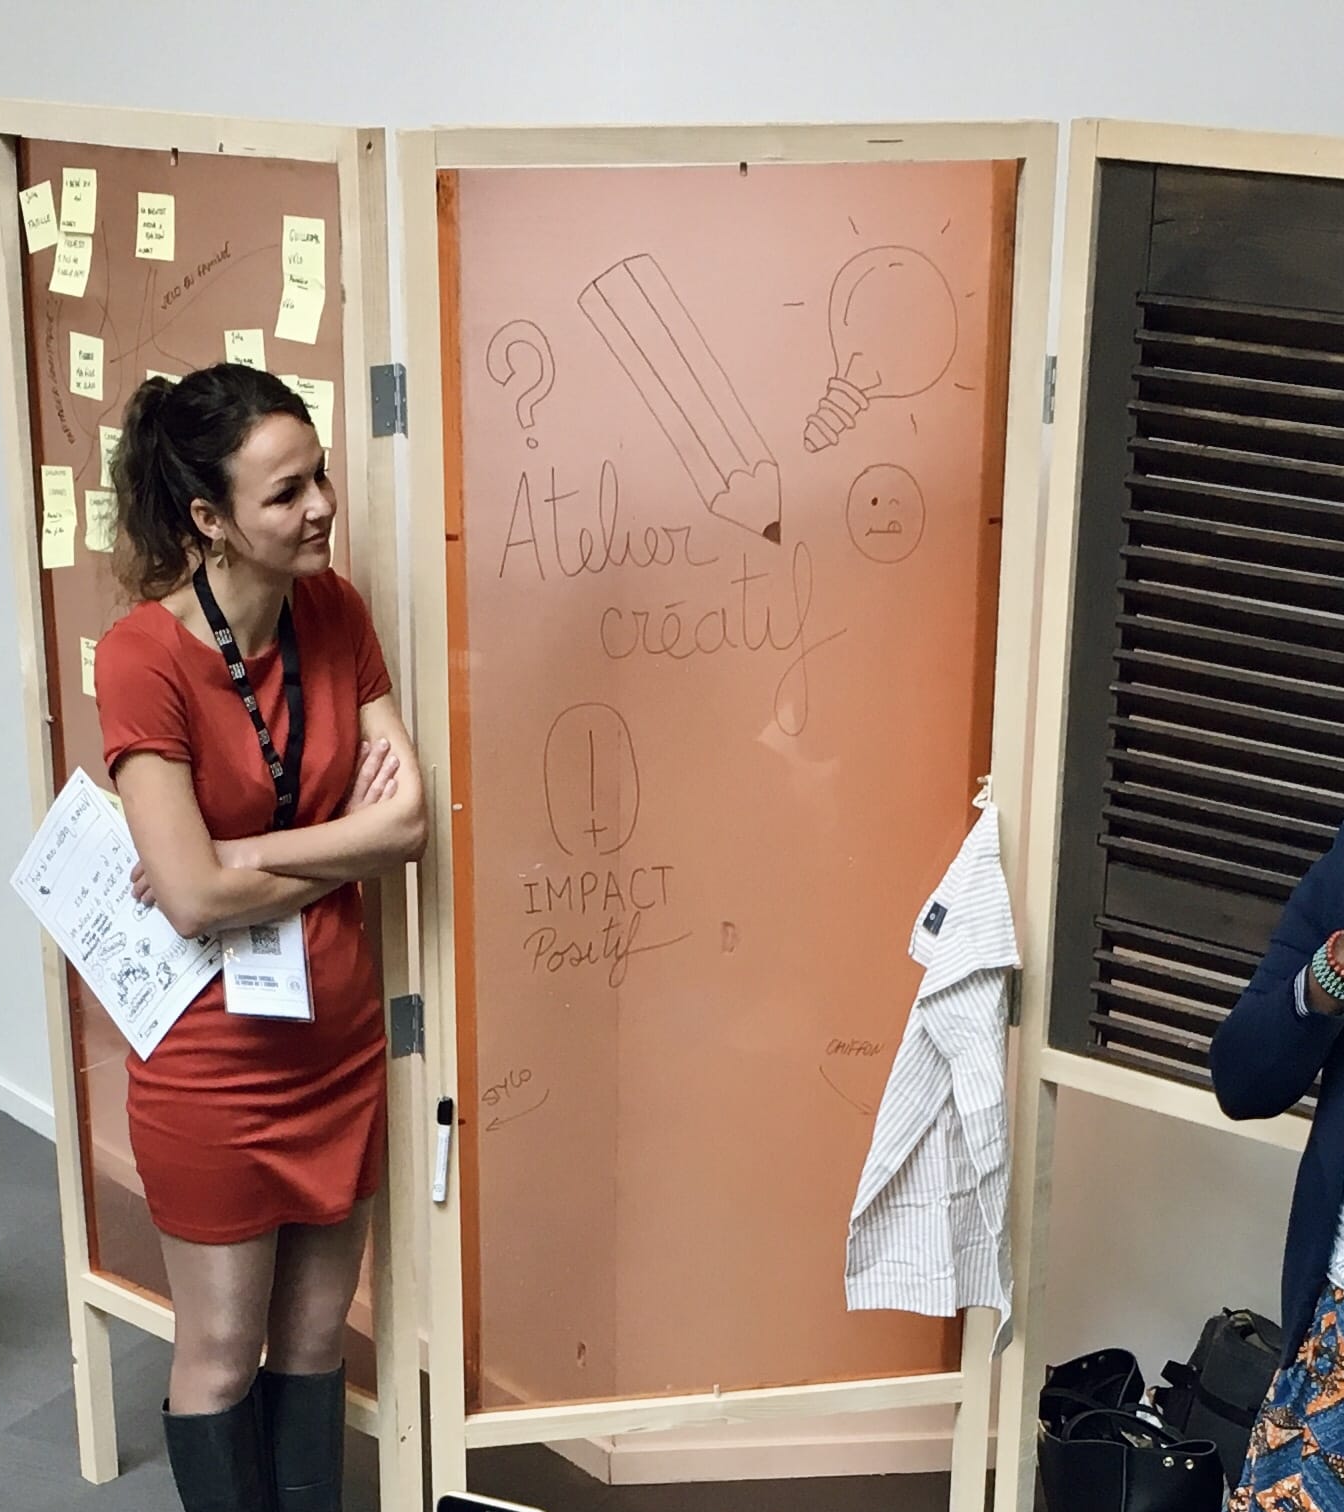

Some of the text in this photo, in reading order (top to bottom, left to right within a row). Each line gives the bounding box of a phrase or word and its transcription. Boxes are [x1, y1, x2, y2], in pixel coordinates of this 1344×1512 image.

[499, 459, 720, 582] Atelier
[523, 865, 675, 915] IMPACT
[523, 911, 693, 989] Positif
[826, 1037, 886, 1057] CHIFFON
